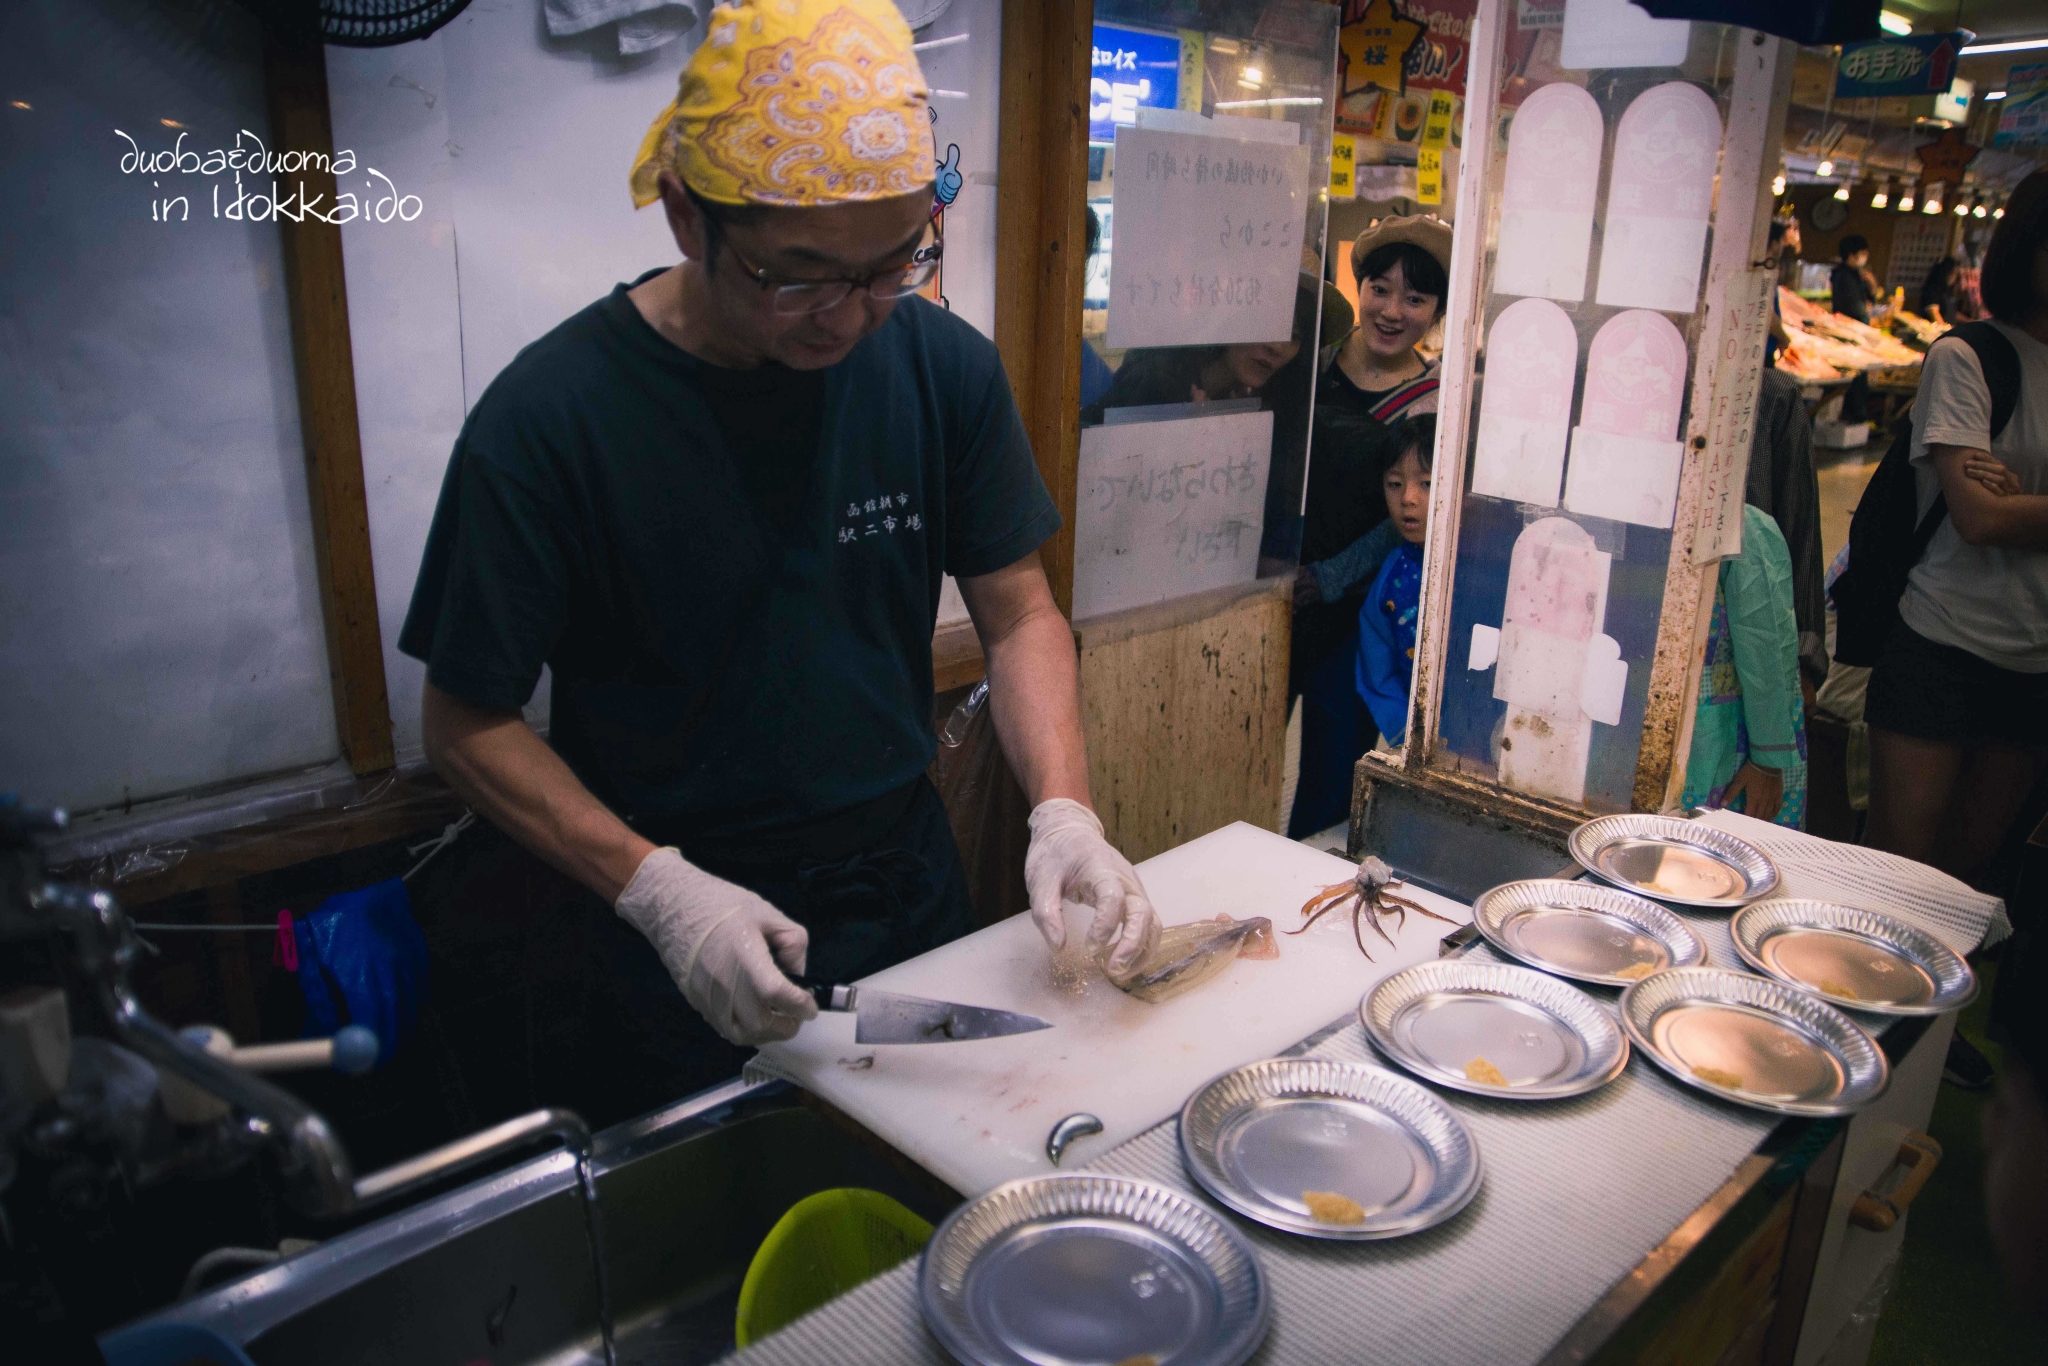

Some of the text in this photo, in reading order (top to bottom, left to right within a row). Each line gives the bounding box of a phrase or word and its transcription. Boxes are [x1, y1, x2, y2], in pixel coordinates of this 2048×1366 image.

[1846, 48, 1924, 80] お手洗
[1701, 309, 1742, 529] NO FLASH
[847, 492, 909, 518] 函館朝市
[838, 513, 922, 543] 駅二市場
